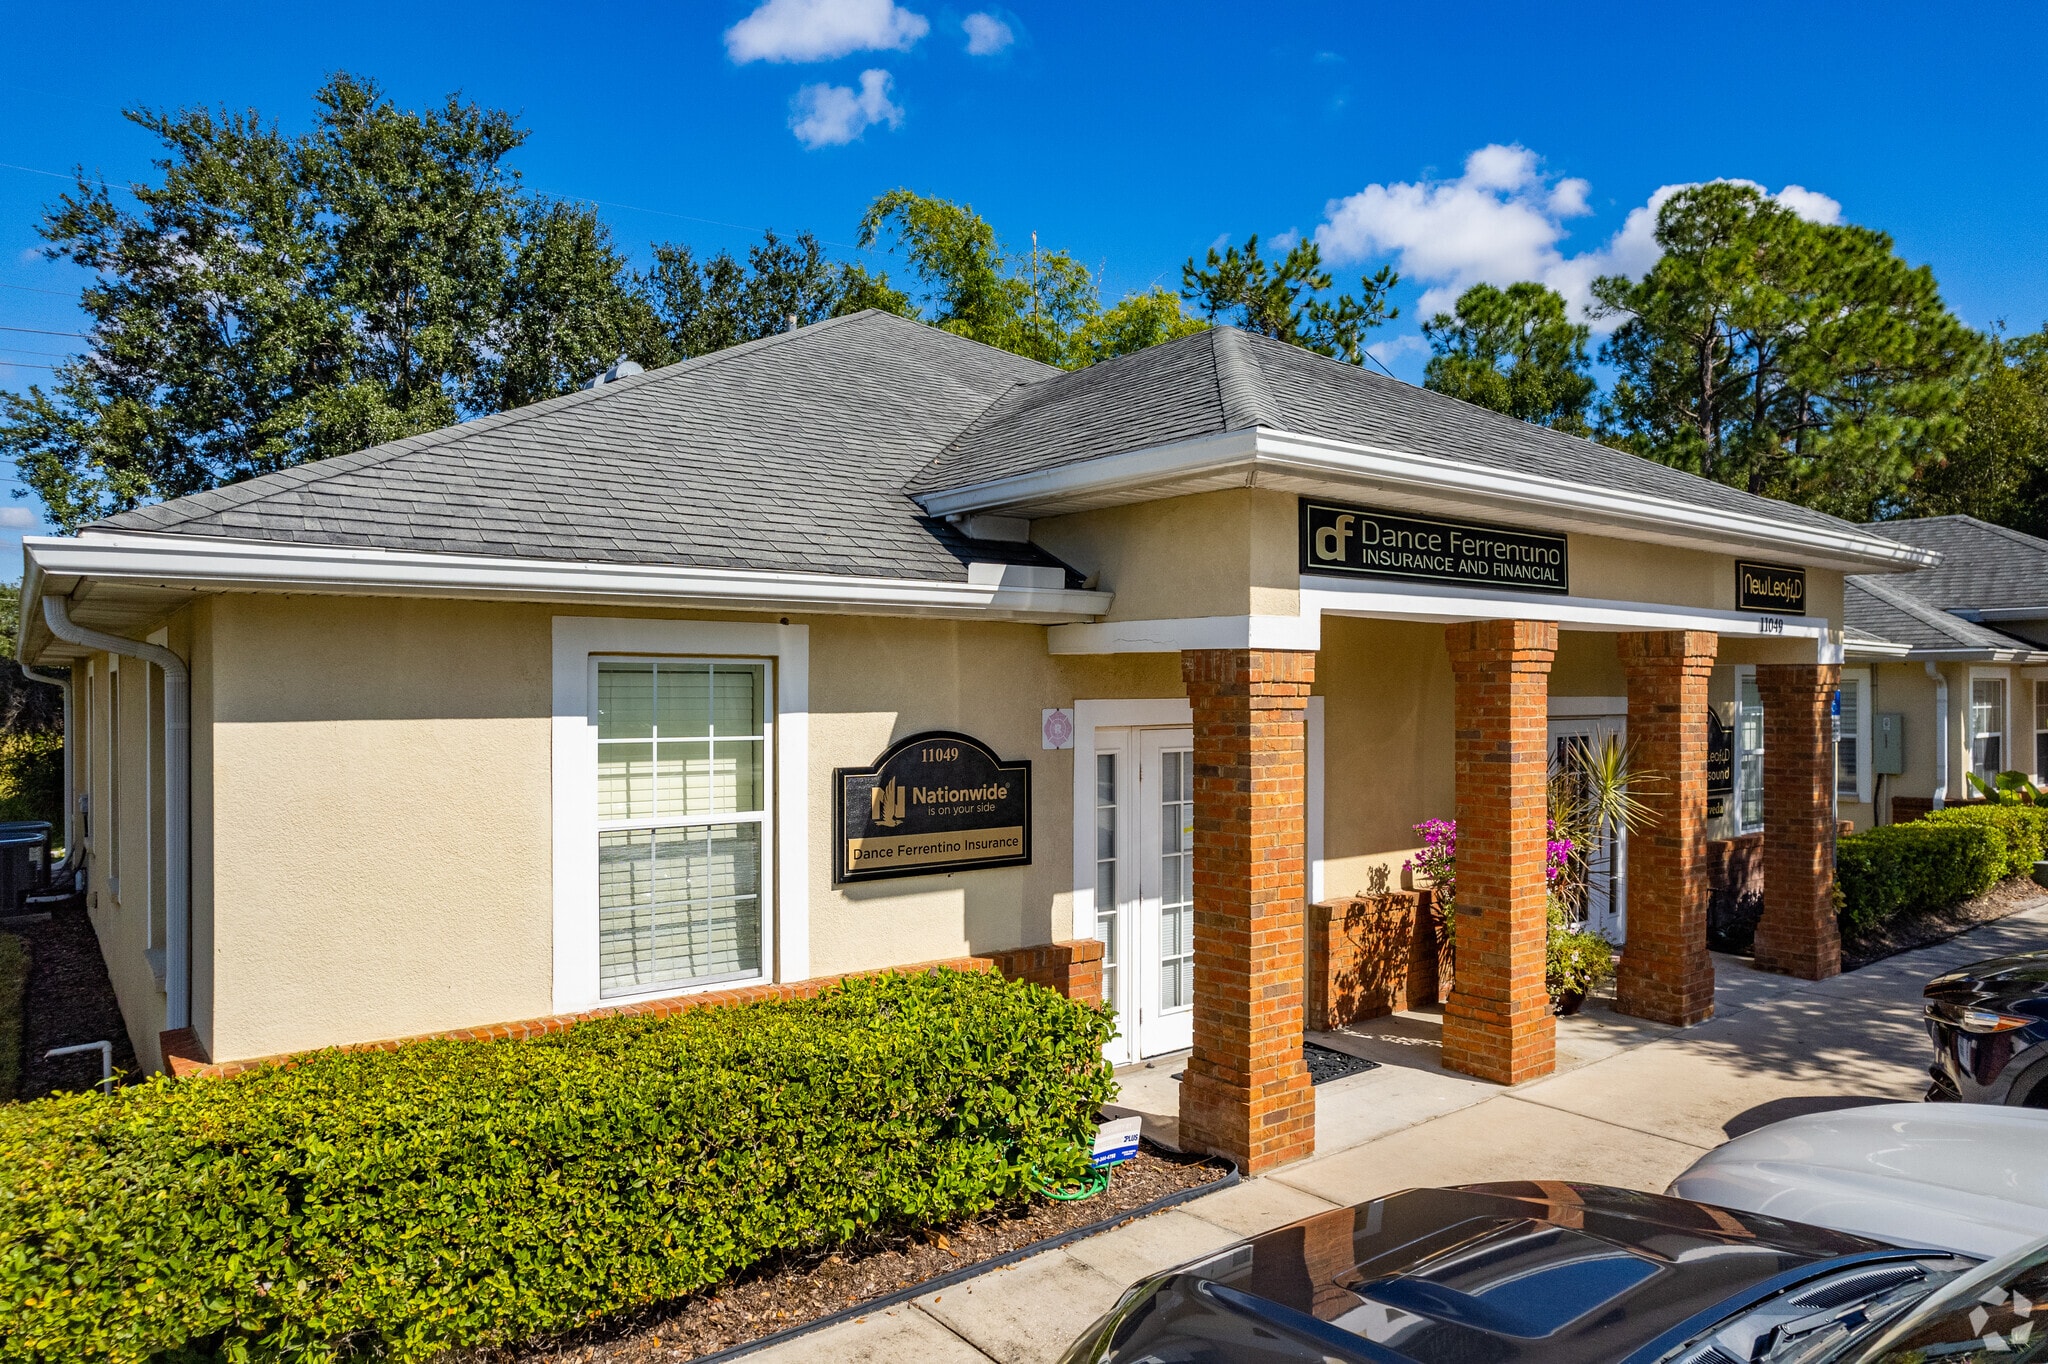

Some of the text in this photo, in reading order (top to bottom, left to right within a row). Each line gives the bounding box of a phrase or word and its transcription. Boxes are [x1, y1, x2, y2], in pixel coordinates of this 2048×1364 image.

[1362, 520, 1560, 565] Dance Ferrentino
[1362, 549, 1560, 582] INSURANCE AND FINANCIAL
[1760, 617, 1784, 633] 11049
[921, 748, 959, 763] 11049
[912, 783, 1008, 804] Nationwide
[928, 799, 996, 816] is on your side
[853, 835, 1019, 860] Dance Ferrentino Insurance
